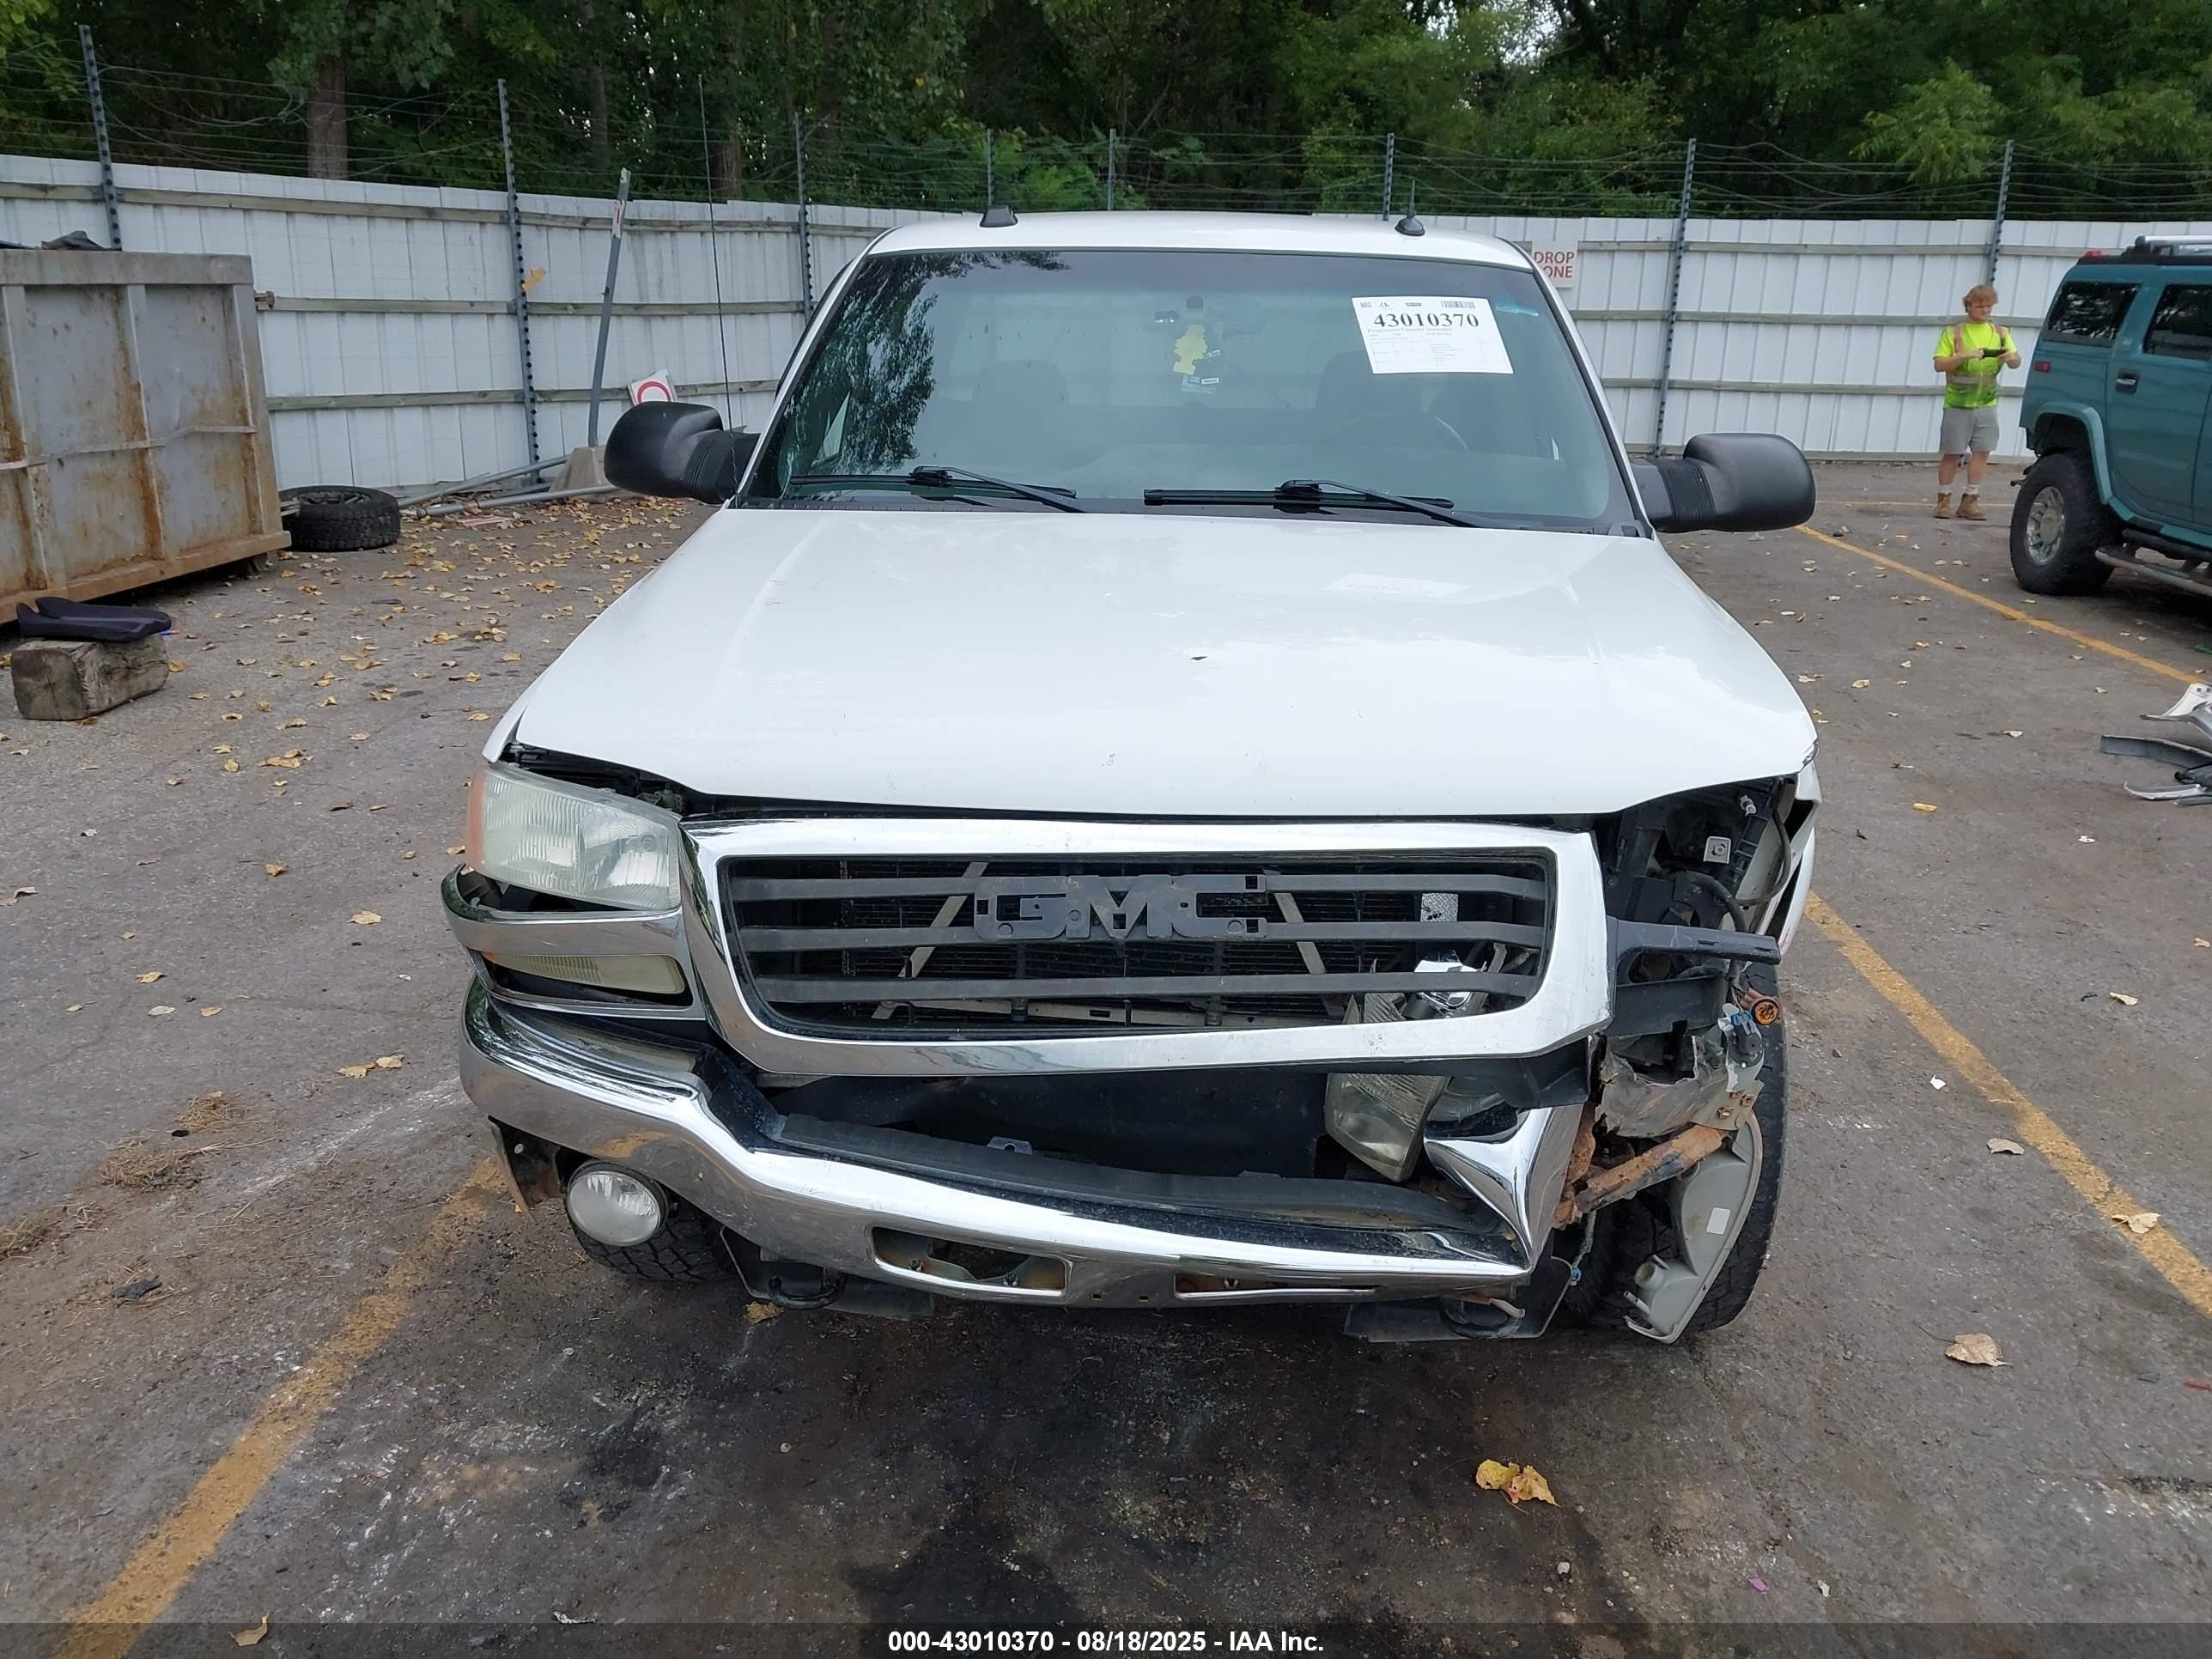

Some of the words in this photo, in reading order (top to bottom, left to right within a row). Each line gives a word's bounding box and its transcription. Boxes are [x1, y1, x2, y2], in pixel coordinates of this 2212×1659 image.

[1534, 251, 1575, 264] DROP
[1541, 265, 1573, 278] ONE
[1373, 313, 1480, 328] 43010370
[974, 874, 1267, 939] GMC
